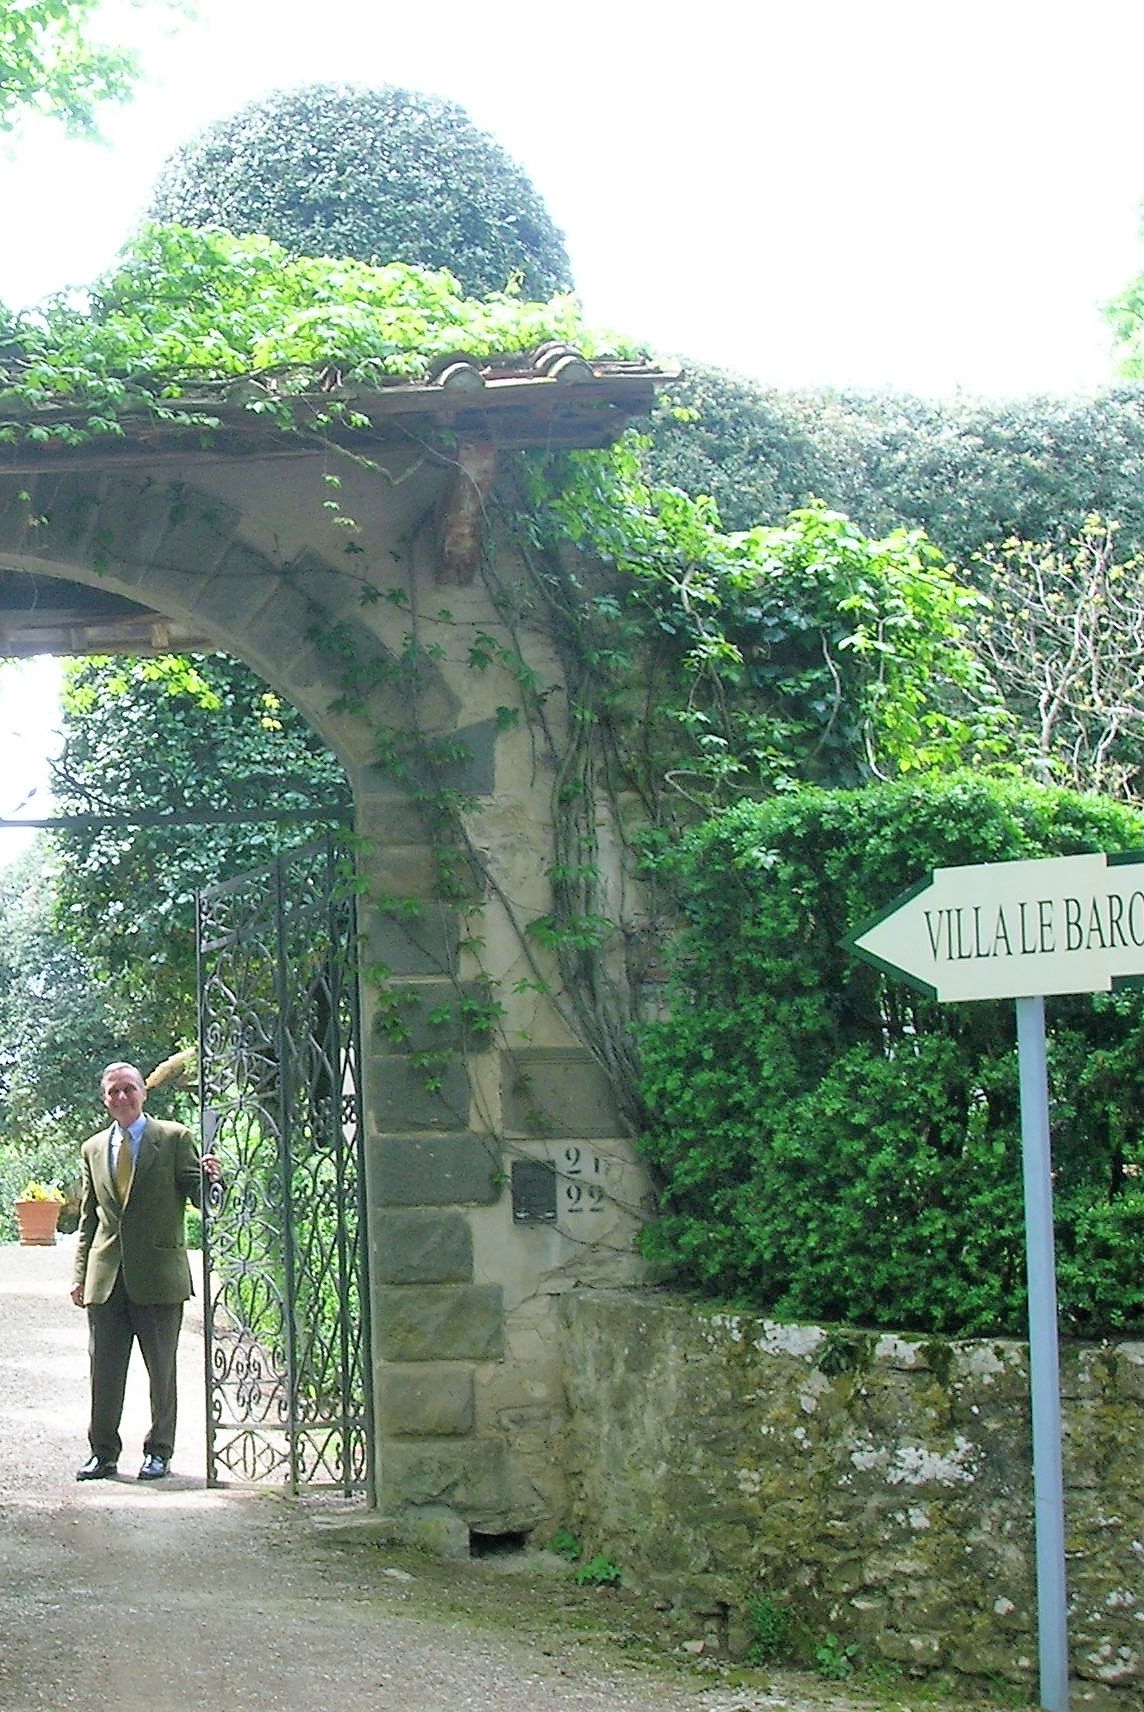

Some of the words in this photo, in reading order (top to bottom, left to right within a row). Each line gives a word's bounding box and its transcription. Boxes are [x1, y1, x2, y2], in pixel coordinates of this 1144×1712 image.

[924, 904, 1013, 962] VILLA
[1018, 900, 1056, 955] LE
[566, 1184, 605, 1212] 22
